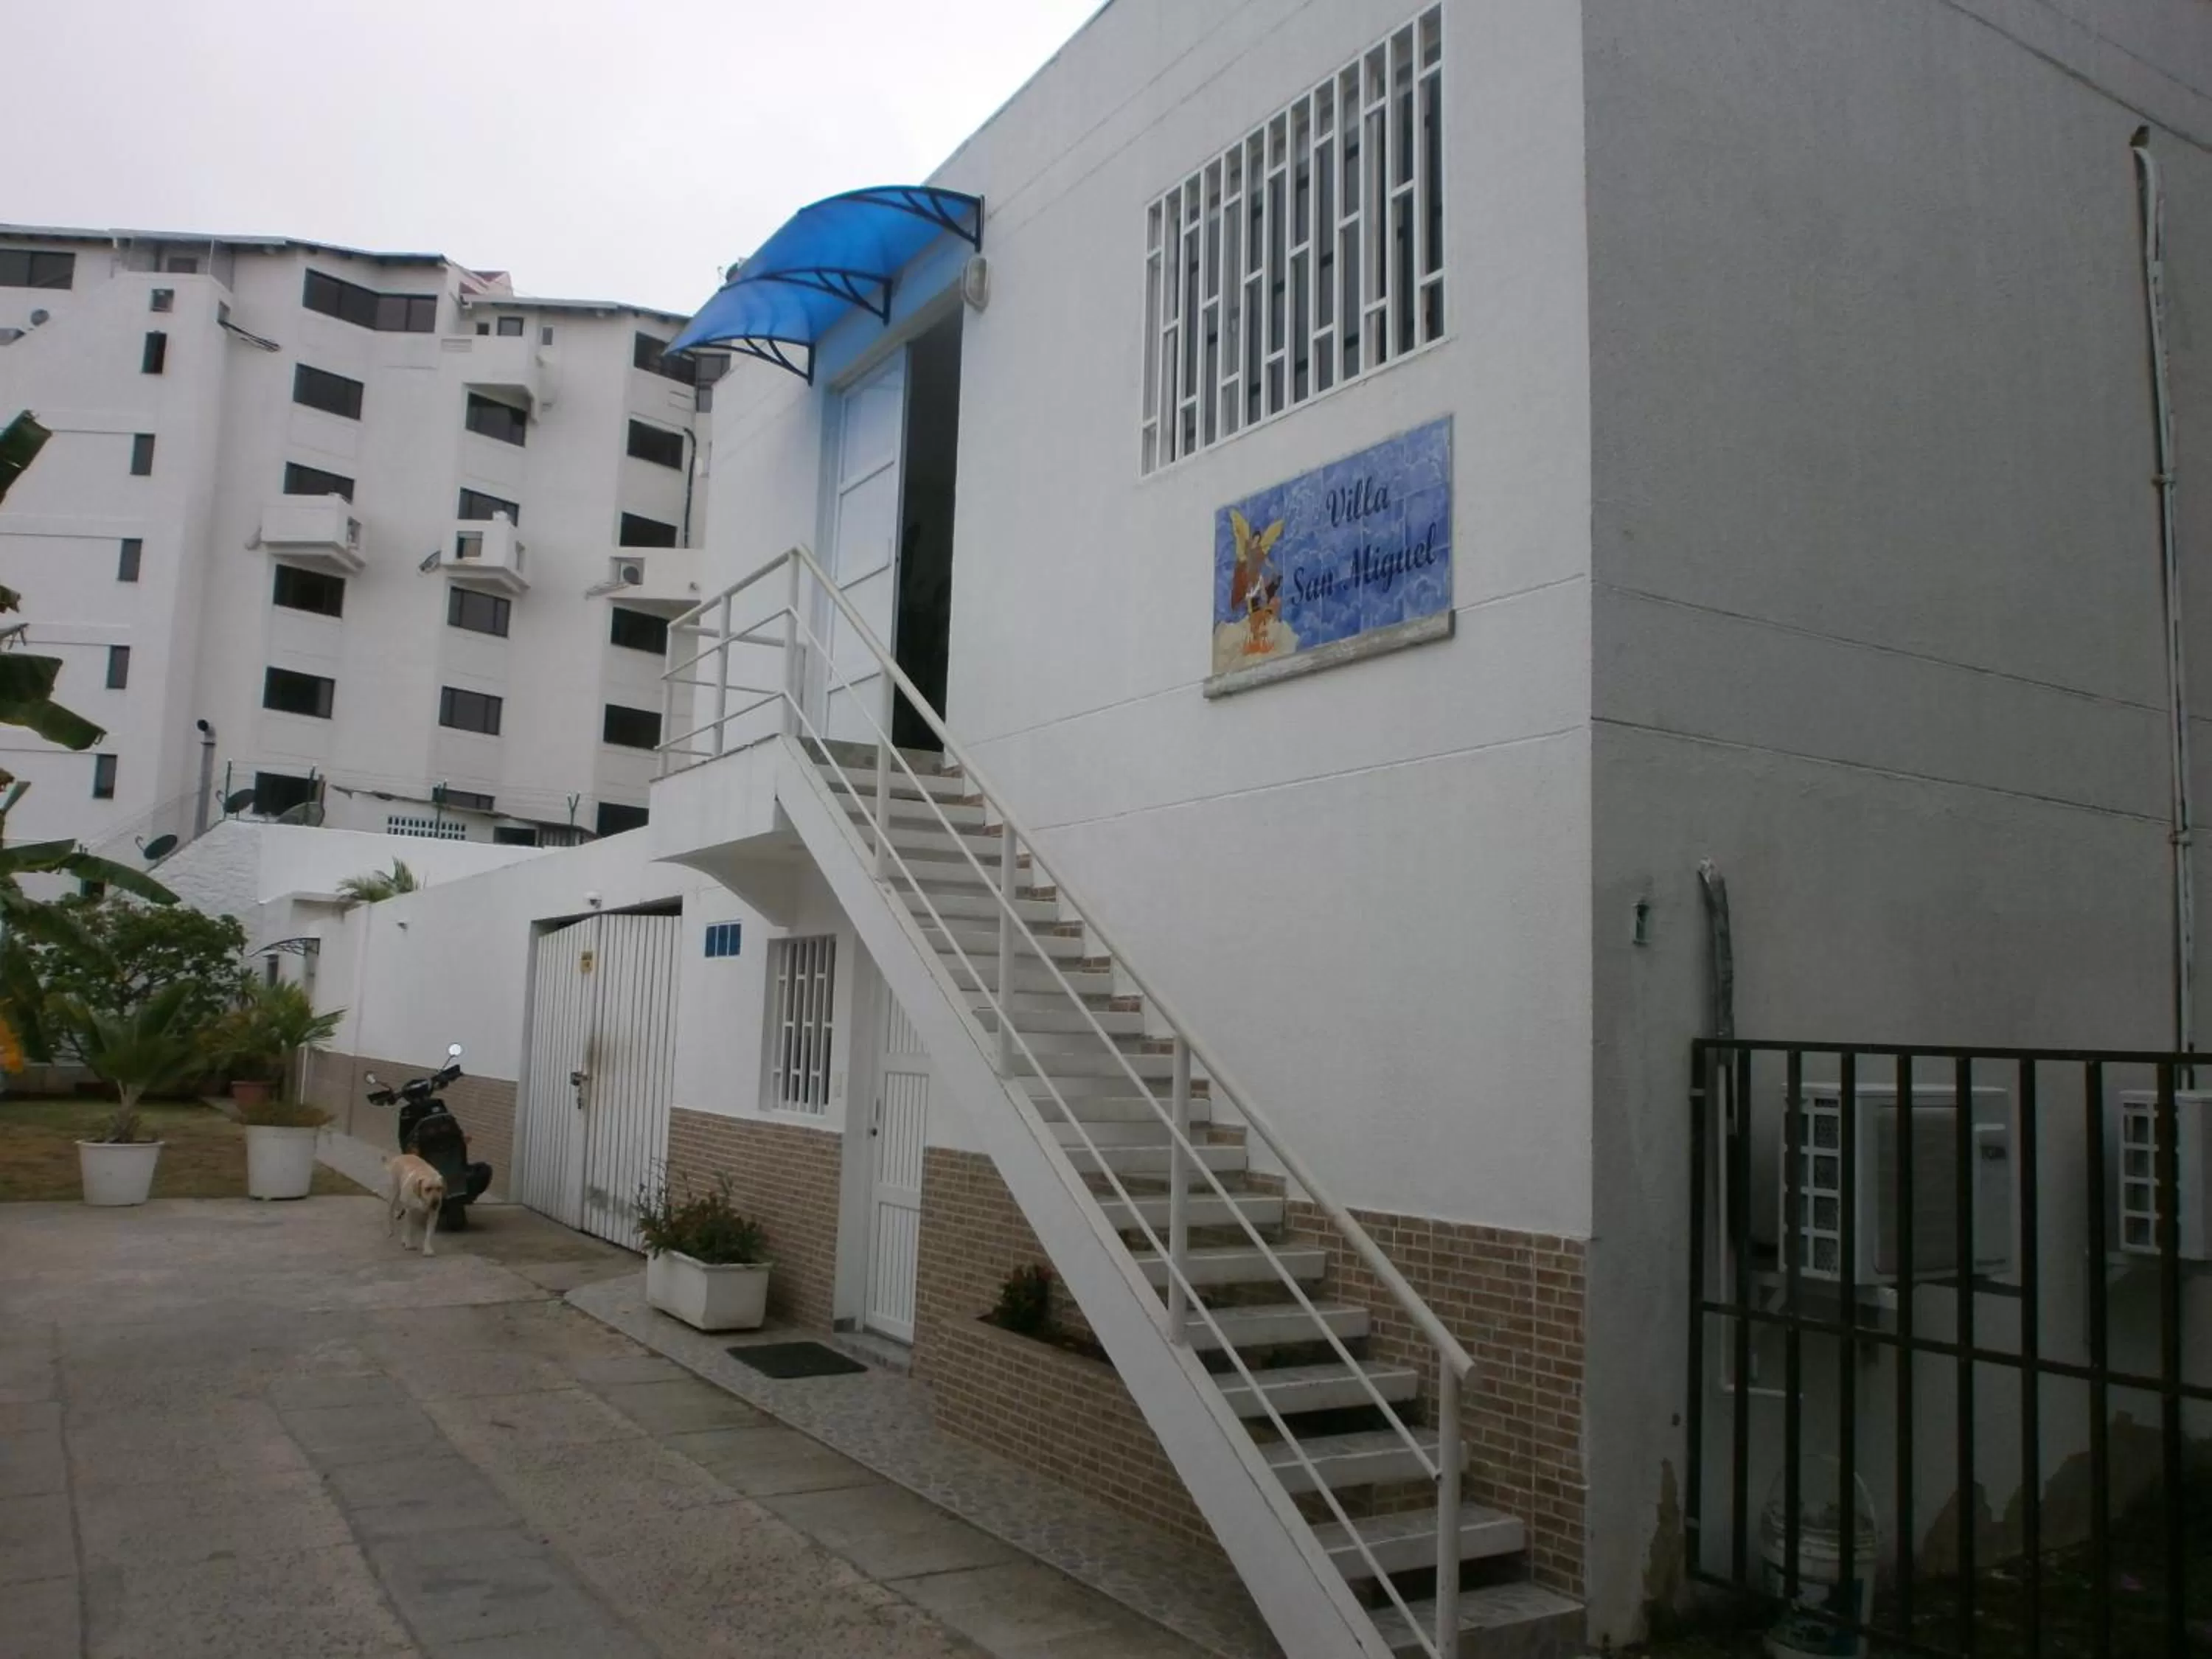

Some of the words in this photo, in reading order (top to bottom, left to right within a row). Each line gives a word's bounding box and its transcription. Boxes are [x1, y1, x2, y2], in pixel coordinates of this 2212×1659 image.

[1326, 476, 1389, 528] Villa
[1292, 567, 1334, 606] San
[1344, 522, 1437, 593] Miguel
